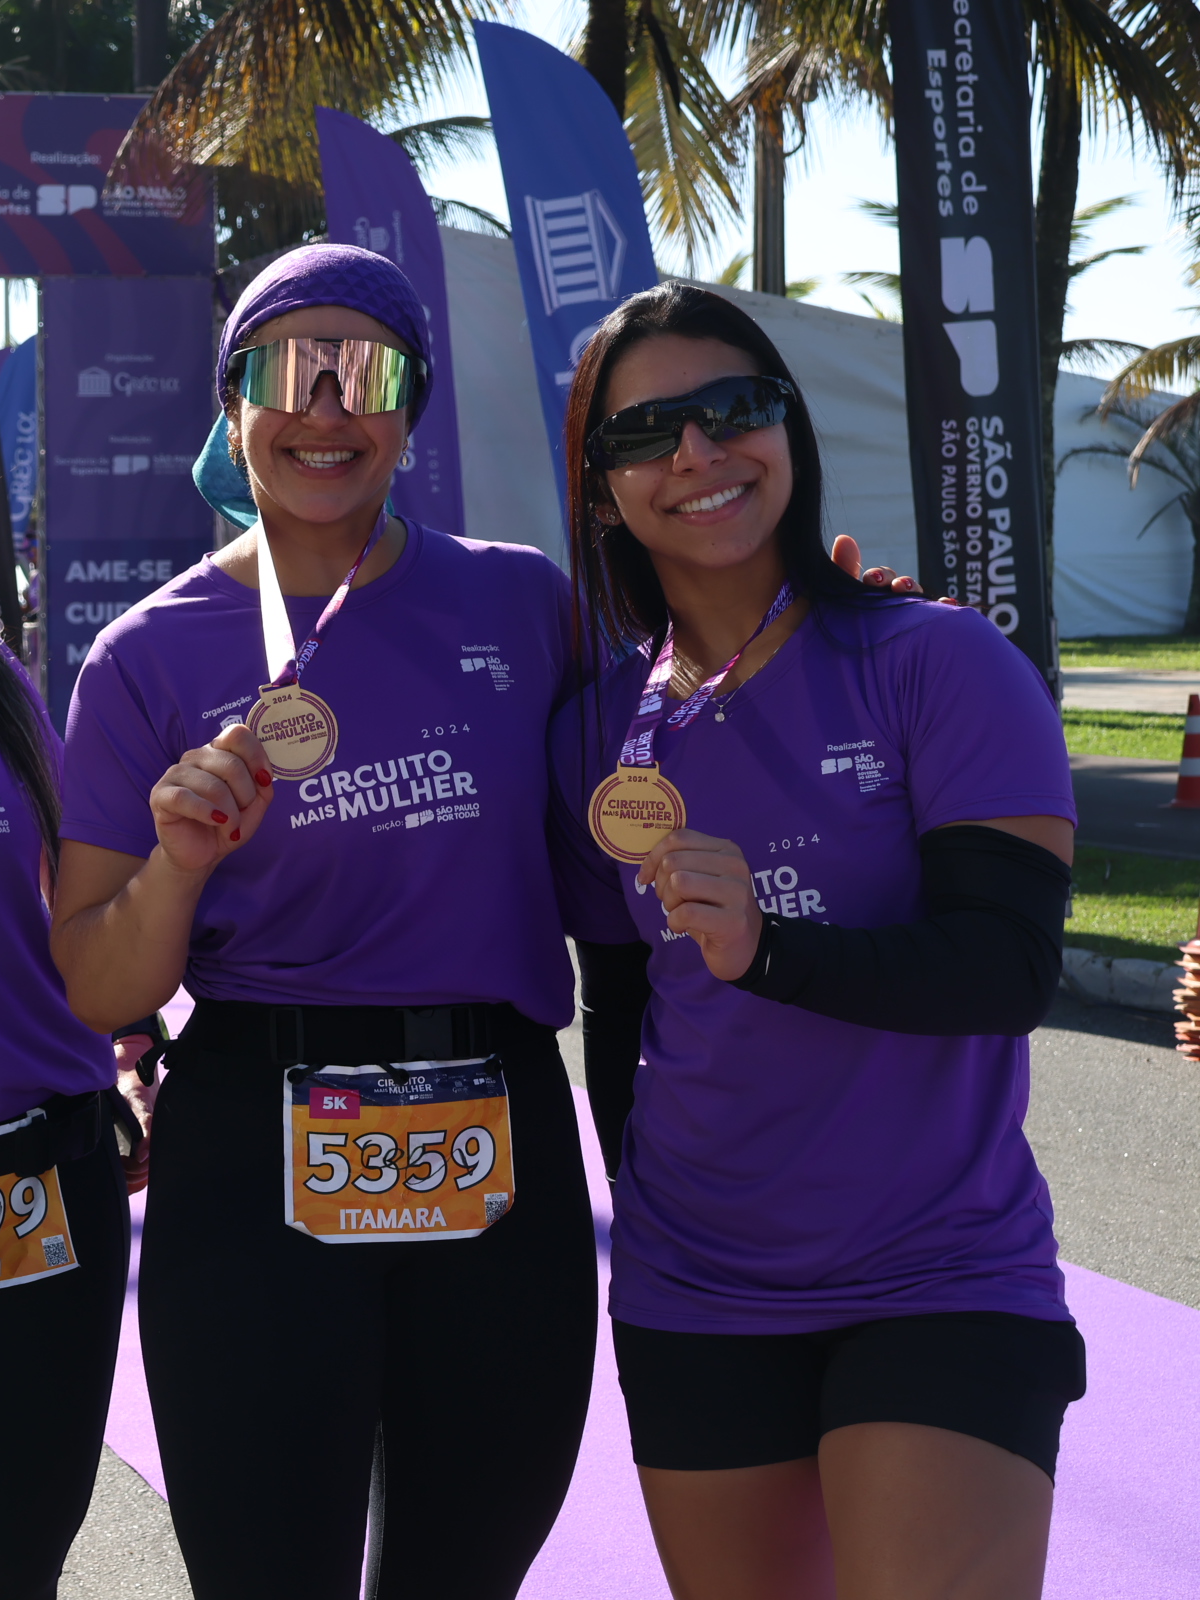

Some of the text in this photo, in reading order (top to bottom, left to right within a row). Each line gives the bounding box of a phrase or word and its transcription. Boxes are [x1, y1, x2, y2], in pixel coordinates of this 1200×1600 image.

[953, 0, 988, 216] ecretaria de
[924, 48, 954, 218] Esportes
[16, 184, 30, 199] de
[966, 416, 982, 519] GOVERNO
[941, 419, 960, 568] SÃO PAULO SÃO
[982, 415, 1020, 636] SÃO PAULO
[966, 525, 983, 556] DO
[64, 560, 173, 583] AME-SE
[201, 695, 253, 720] Organização:
[272, 694, 293, 705] 2024
[261, 712, 316, 735] CIRCUITO
[274, 720, 326, 742] MULHER
[421, 723, 471, 739] 2024
[827, 739, 876, 752] Realização:
[854, 752, 874, 764] SÃO
[855, 760, 885, 771] PAULO
[299, 749, 453, 804] CIRCUITO
[627, 775, 649, 783] 2024
[290, 771, 478, 829] MAIS MULHER
[436, 802, 480, 816] SÃO PAULO
[607, 799, 666, 811] CIRCUITO
[436, 809, 480, 823] POR TODAS
[619, 809, 672, 821] MULHER
[372, 819, 404, 834] EDIÇÃO:
[768, 833, 821, 853] 2024
[388, 1083, 433, 1095] MULHER
[322, 1096, 348, 1110] 5K
[303, 1125, 497, 1195] 5359
[339, 1206, 447, 1230] ITAMARA
